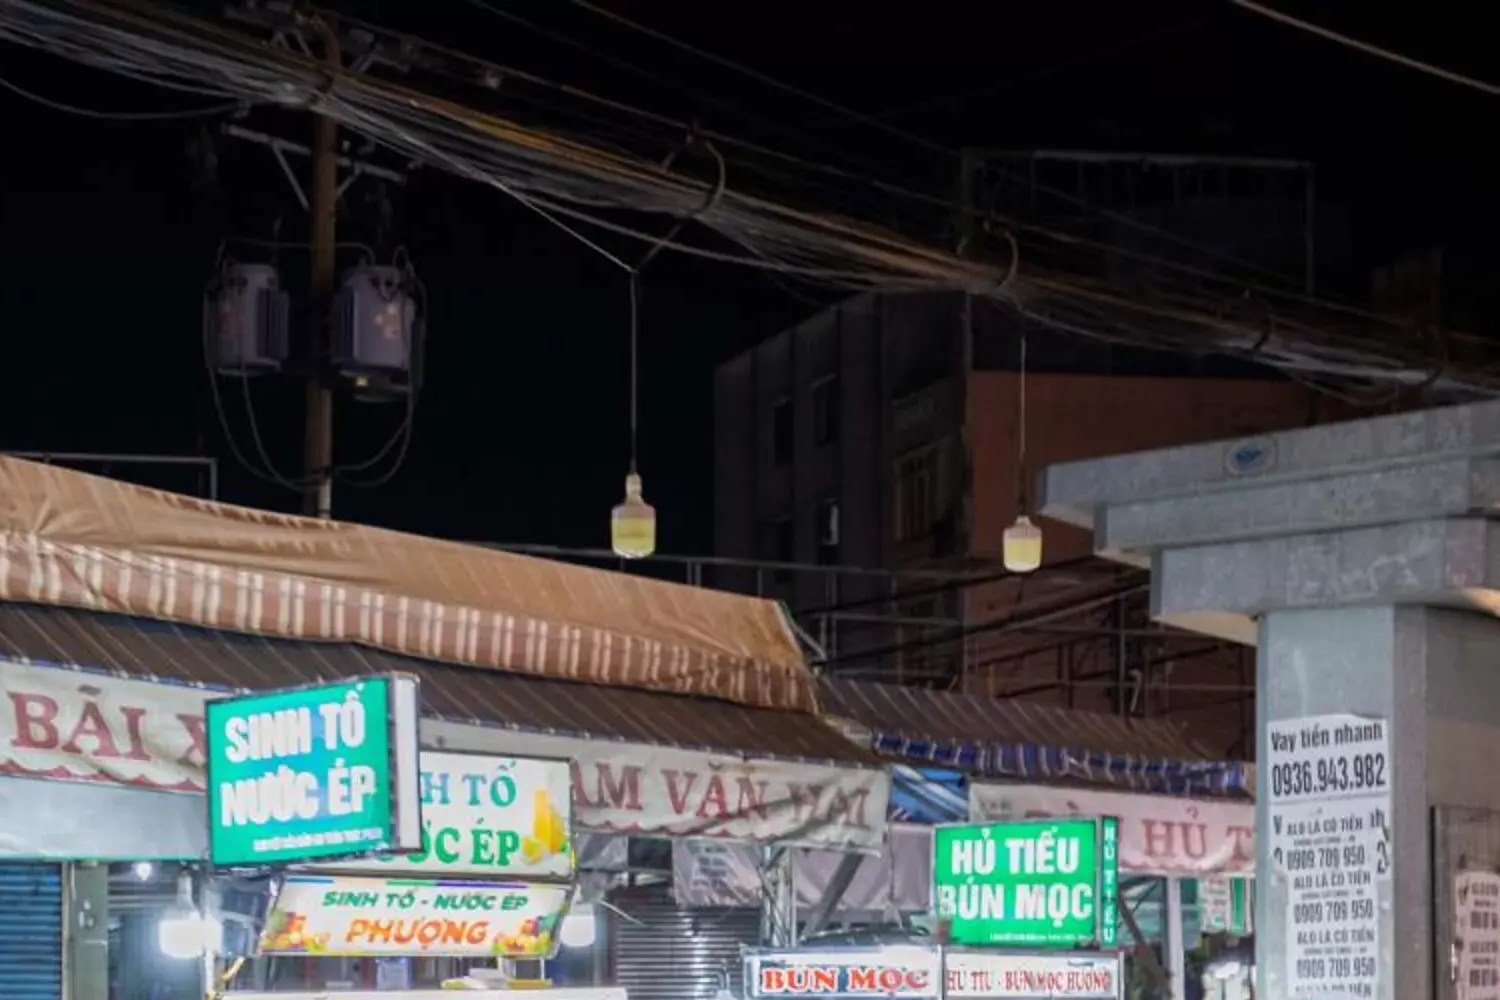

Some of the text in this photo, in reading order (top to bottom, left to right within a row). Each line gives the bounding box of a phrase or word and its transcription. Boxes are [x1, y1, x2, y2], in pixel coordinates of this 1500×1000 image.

[224, 682, 366, 763] SINH TỐ
[1334, 722, 1383, 746] nhanh
[219, 763, 321, 827] NƯỚC
[327, 756, 378, 815] ÉP
[461, 760, 518, 808] TỐ
[660, 760, 771, 821] VĂN
[1272, 752, 1386, 797] 0936.943.982
[470, 817, 520, 867] ÉP
[951, 825, 1080, 875] HỦ TIẾU
[322, 890, 379, 908] SINH
[386, 886, 416, 909] TỐ
[500, 890, 529, 911] ÉP
[937, 876, 1093, 928] BÚN MỌC
[345, 915, 490, 950] PHƯỢNG
